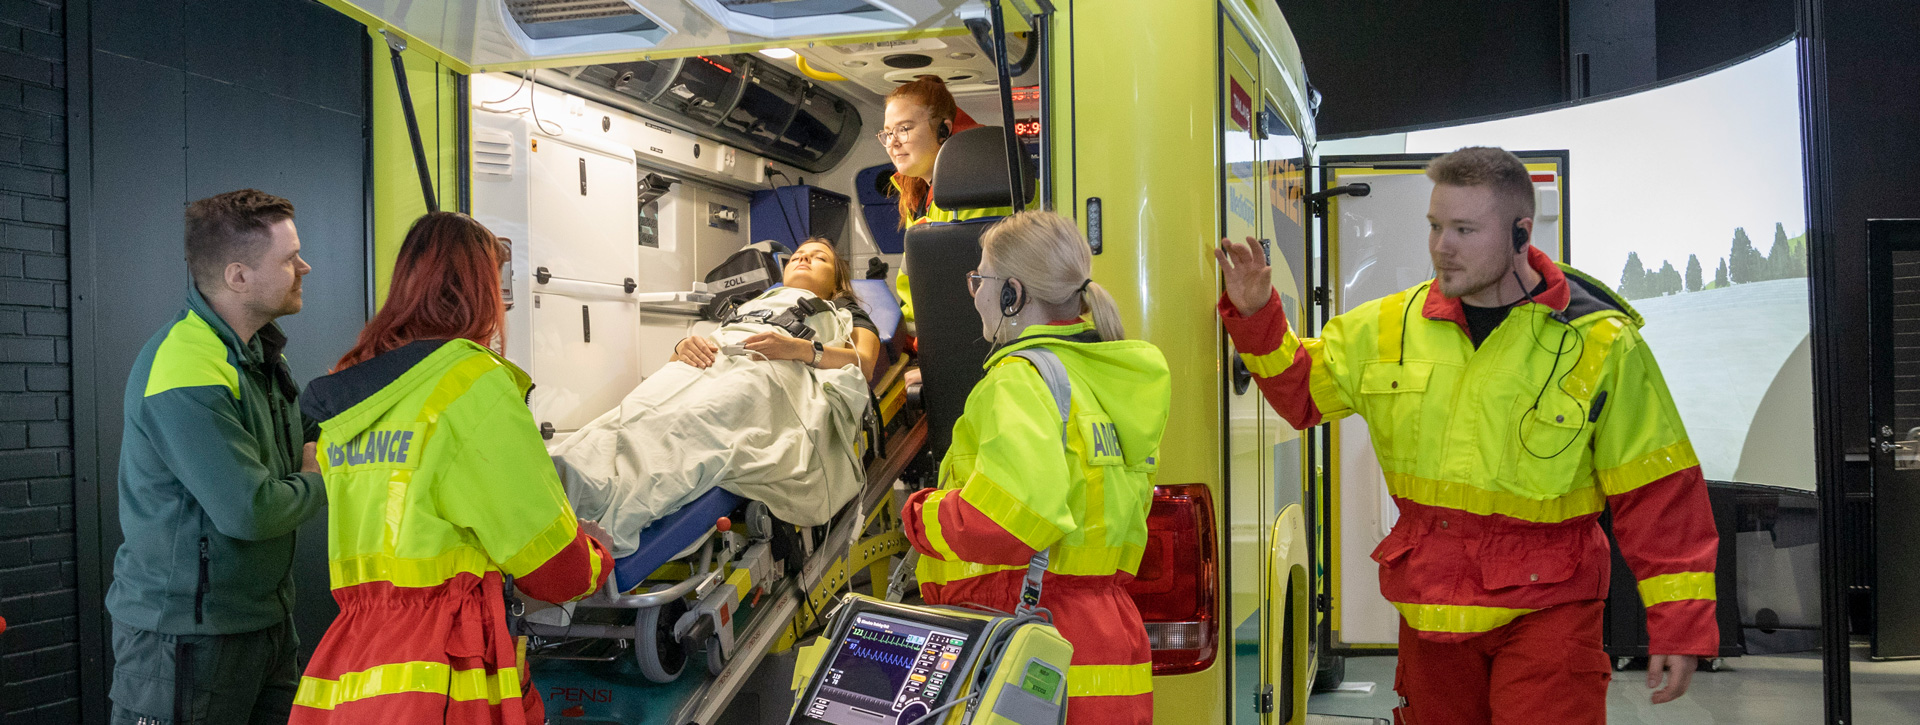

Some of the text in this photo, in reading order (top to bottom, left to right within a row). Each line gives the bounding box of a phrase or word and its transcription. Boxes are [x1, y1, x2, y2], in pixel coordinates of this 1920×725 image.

[724, 276, 745, 289] ZOLL
[327, 429, 414, 467] BULANCE
[550, 687, 612, 703] PENSI
